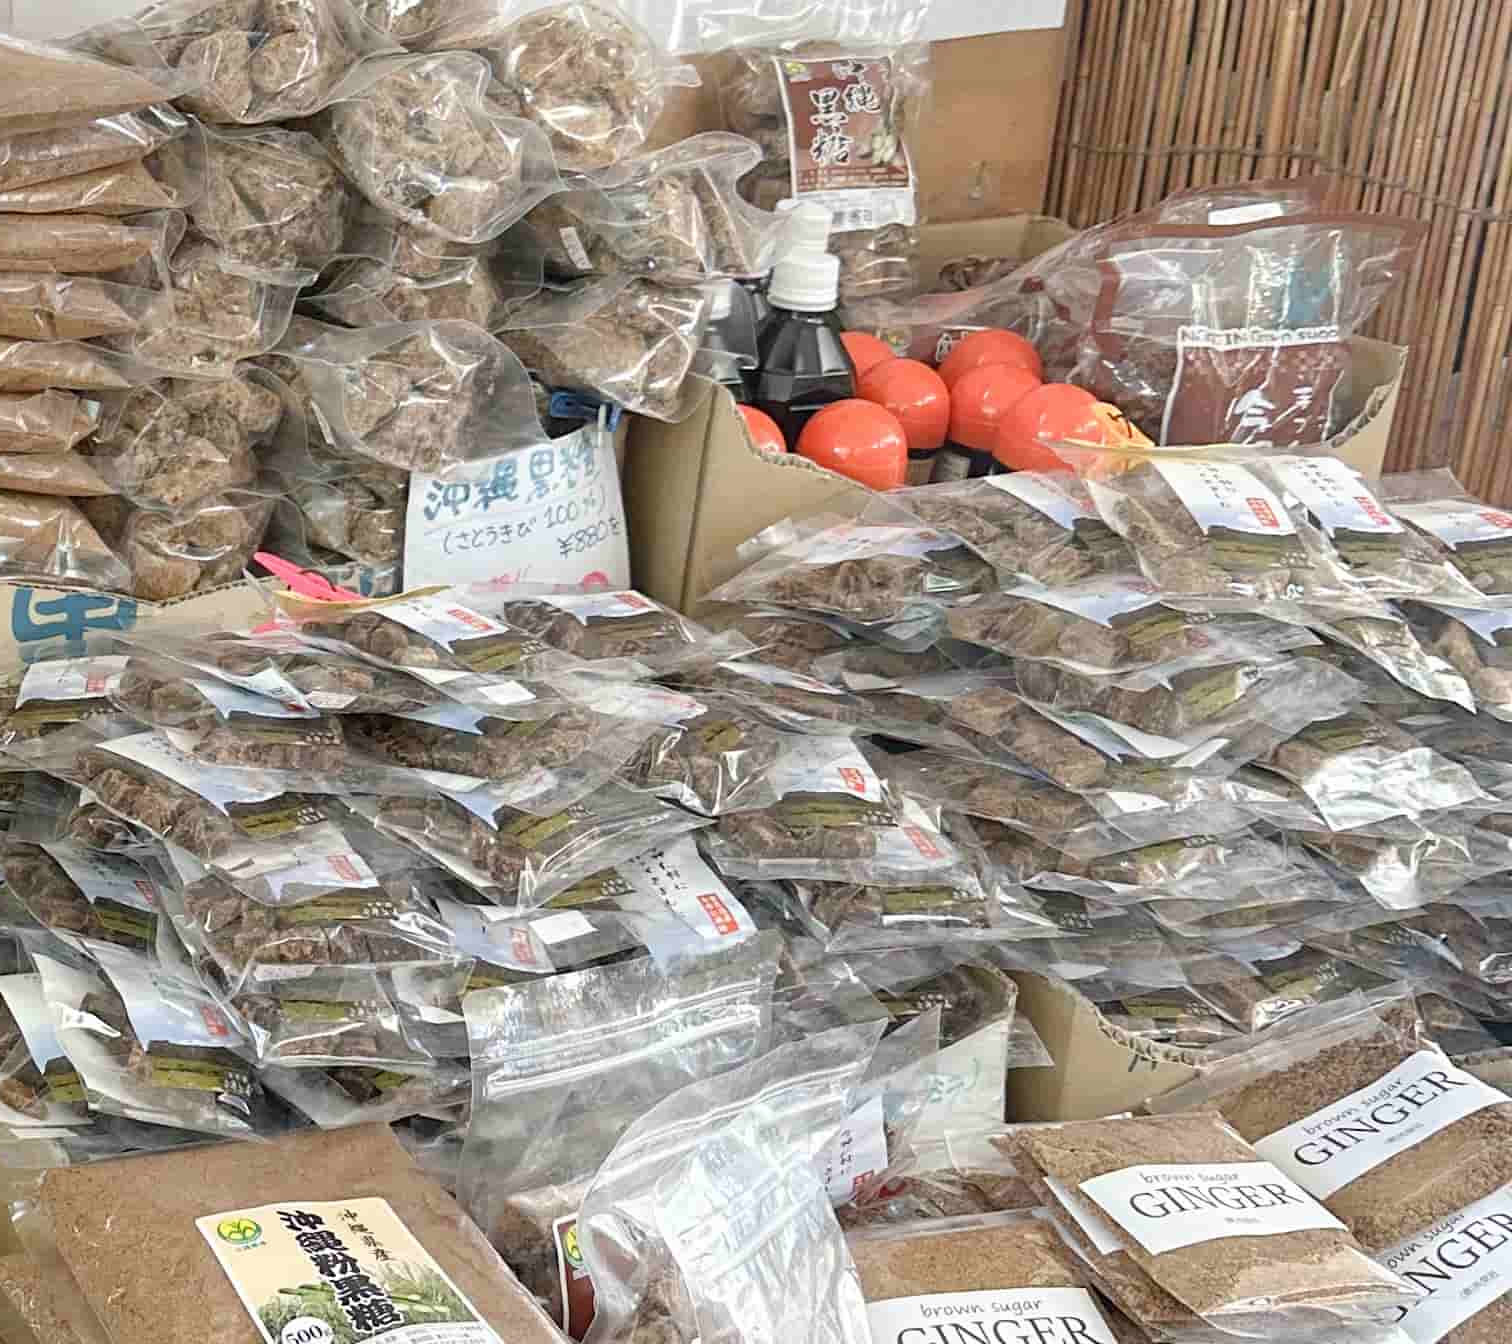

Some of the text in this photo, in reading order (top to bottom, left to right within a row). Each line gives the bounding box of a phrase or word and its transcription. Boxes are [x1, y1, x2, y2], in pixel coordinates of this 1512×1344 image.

[1293, 1068, 1471, 1170] GINGER
[1128, 1182, 1305, 1220] GINGER
[919, 1296, 1045, 1318] brown sugar
